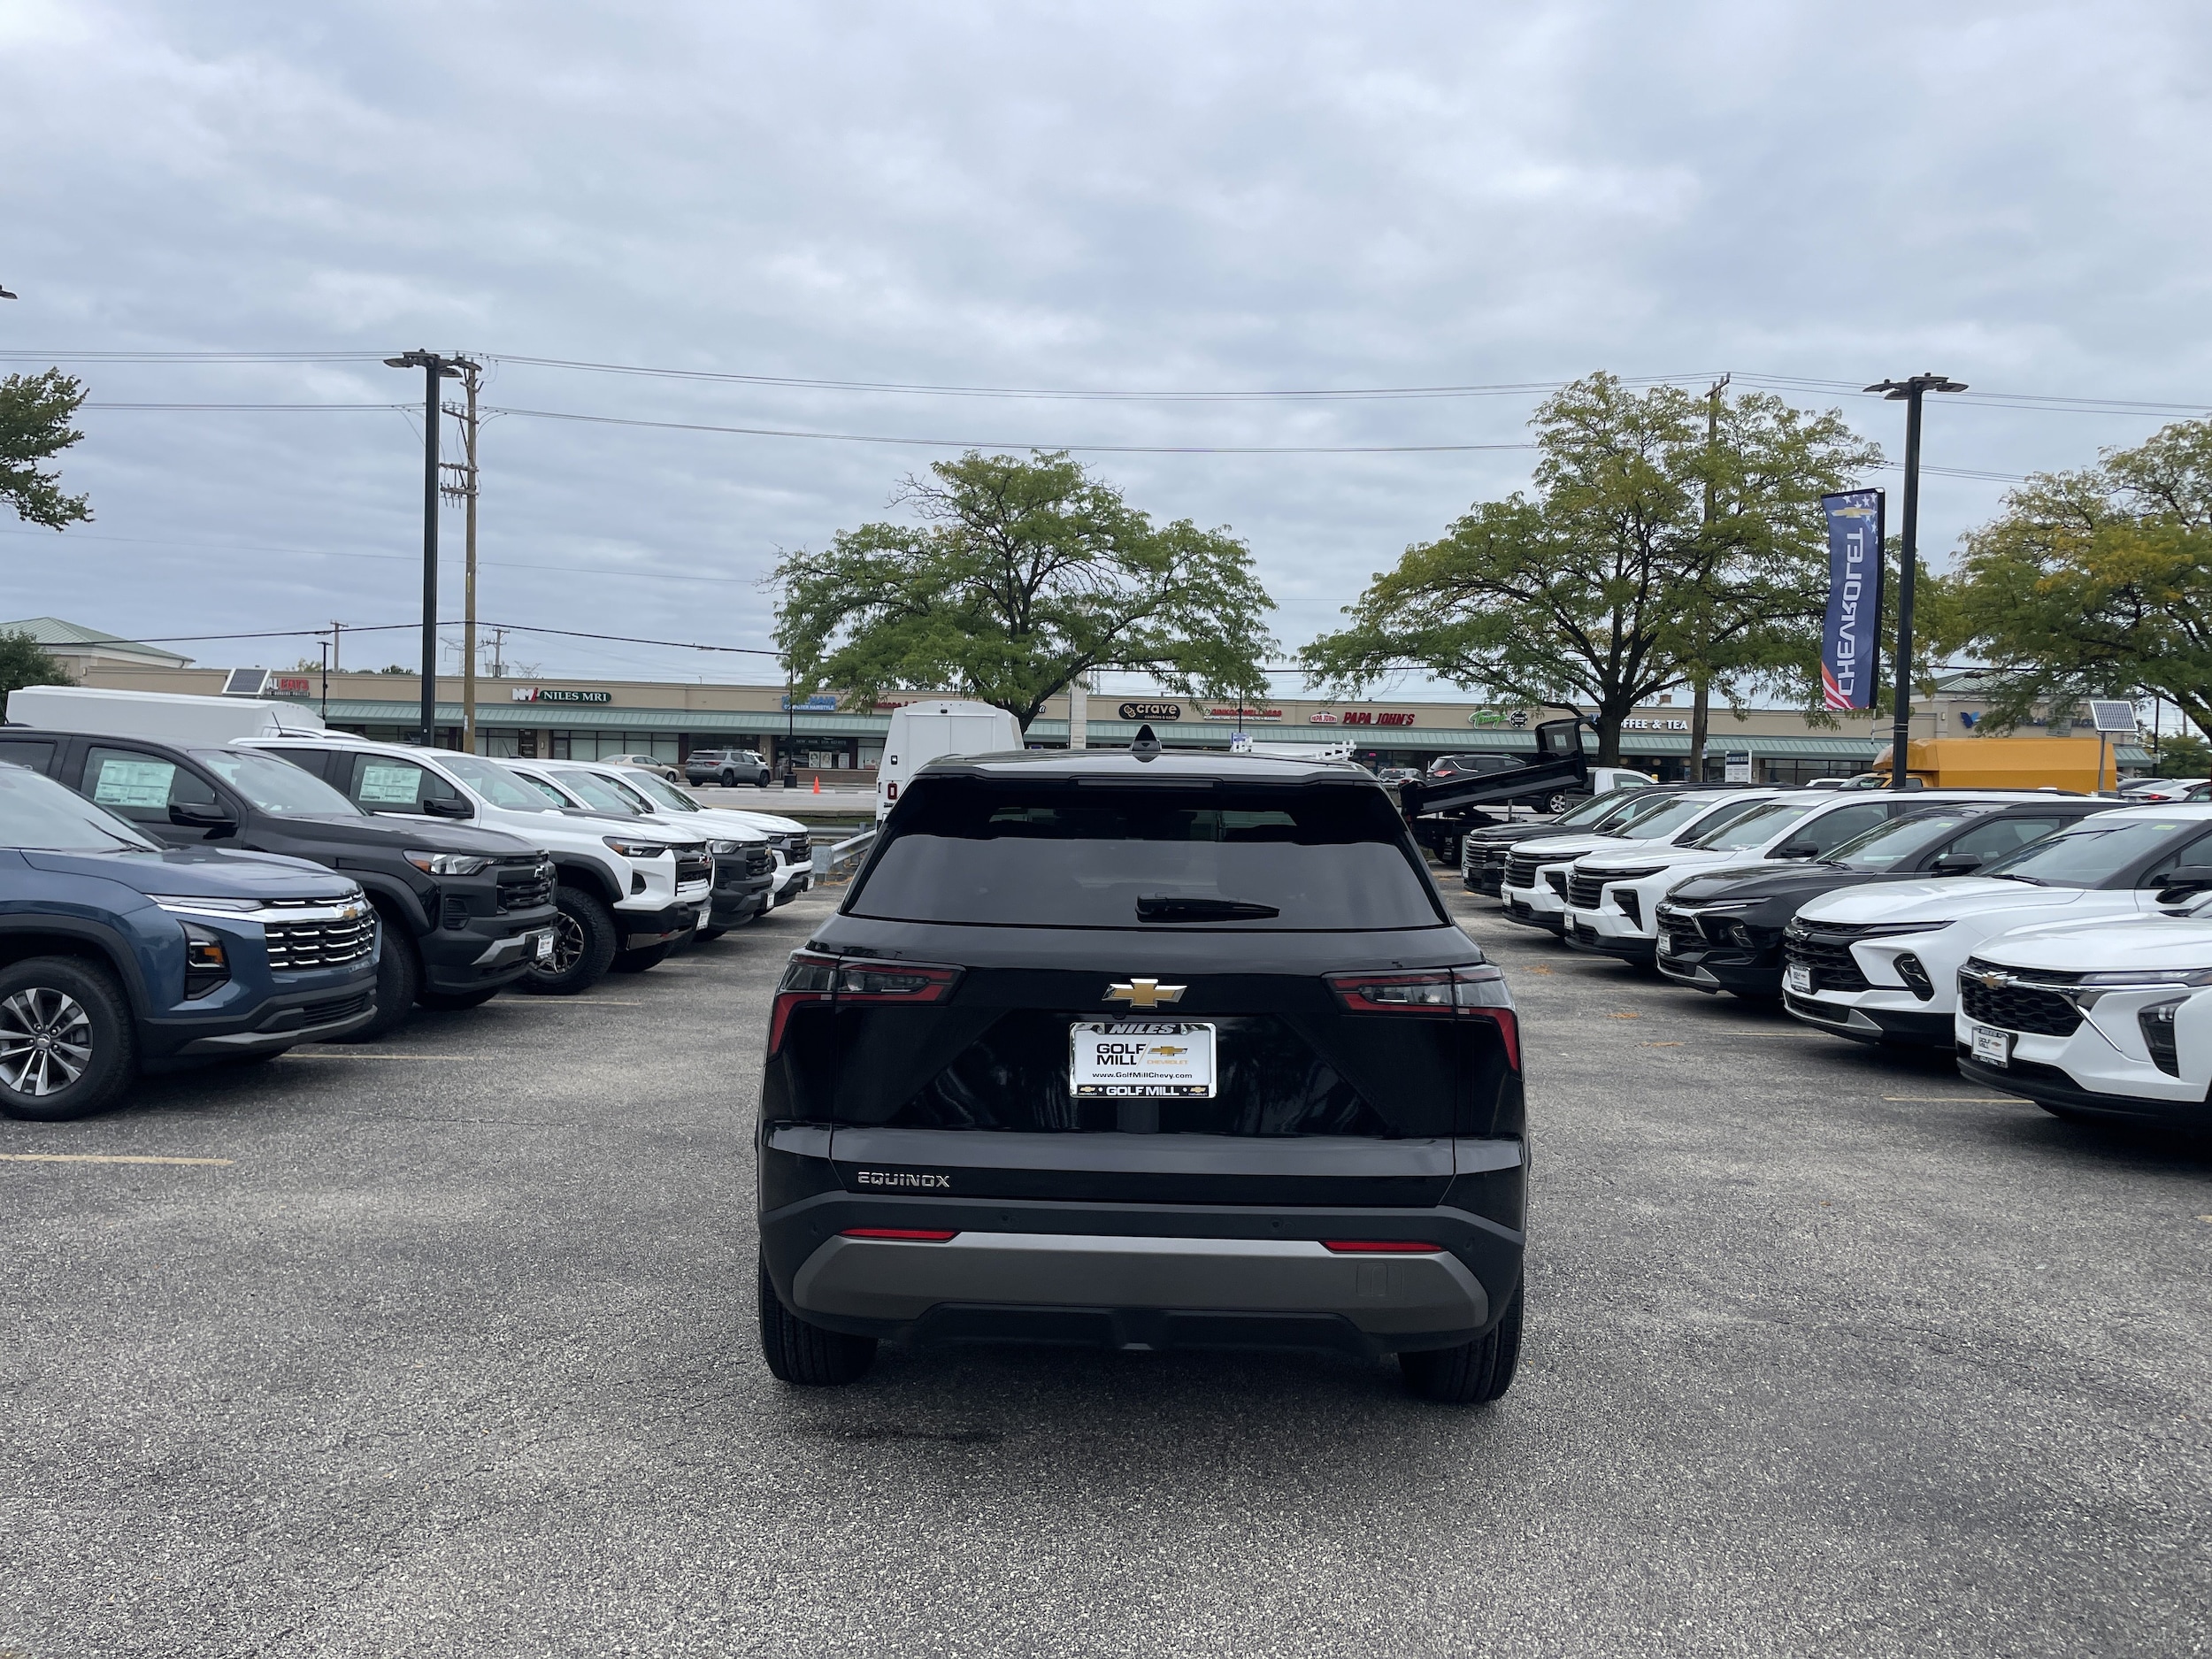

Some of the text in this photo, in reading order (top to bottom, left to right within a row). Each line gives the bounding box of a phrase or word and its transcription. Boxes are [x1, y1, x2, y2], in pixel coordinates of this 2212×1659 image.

[543, 691, 608, 702] NILES MRI
[1136, 704, 1178, 715] crave
[1342, 711, 1416, 726] PAPA JOHN'S
[1652, 719, 1662, 729] &
[1666, 719, 1688, 730] TEA
[1109, 1023, 1177, 1034] NILES
[1096, 1043, 1147, 1055] GOLF
[1096, 1055, 1138, 1065] MILL
[1106, 1086, 1144, 1096] GOLF
[1145, 1086, 1180, 1096] MILL
[857, 1171, 950, 1187] EQUINOX
